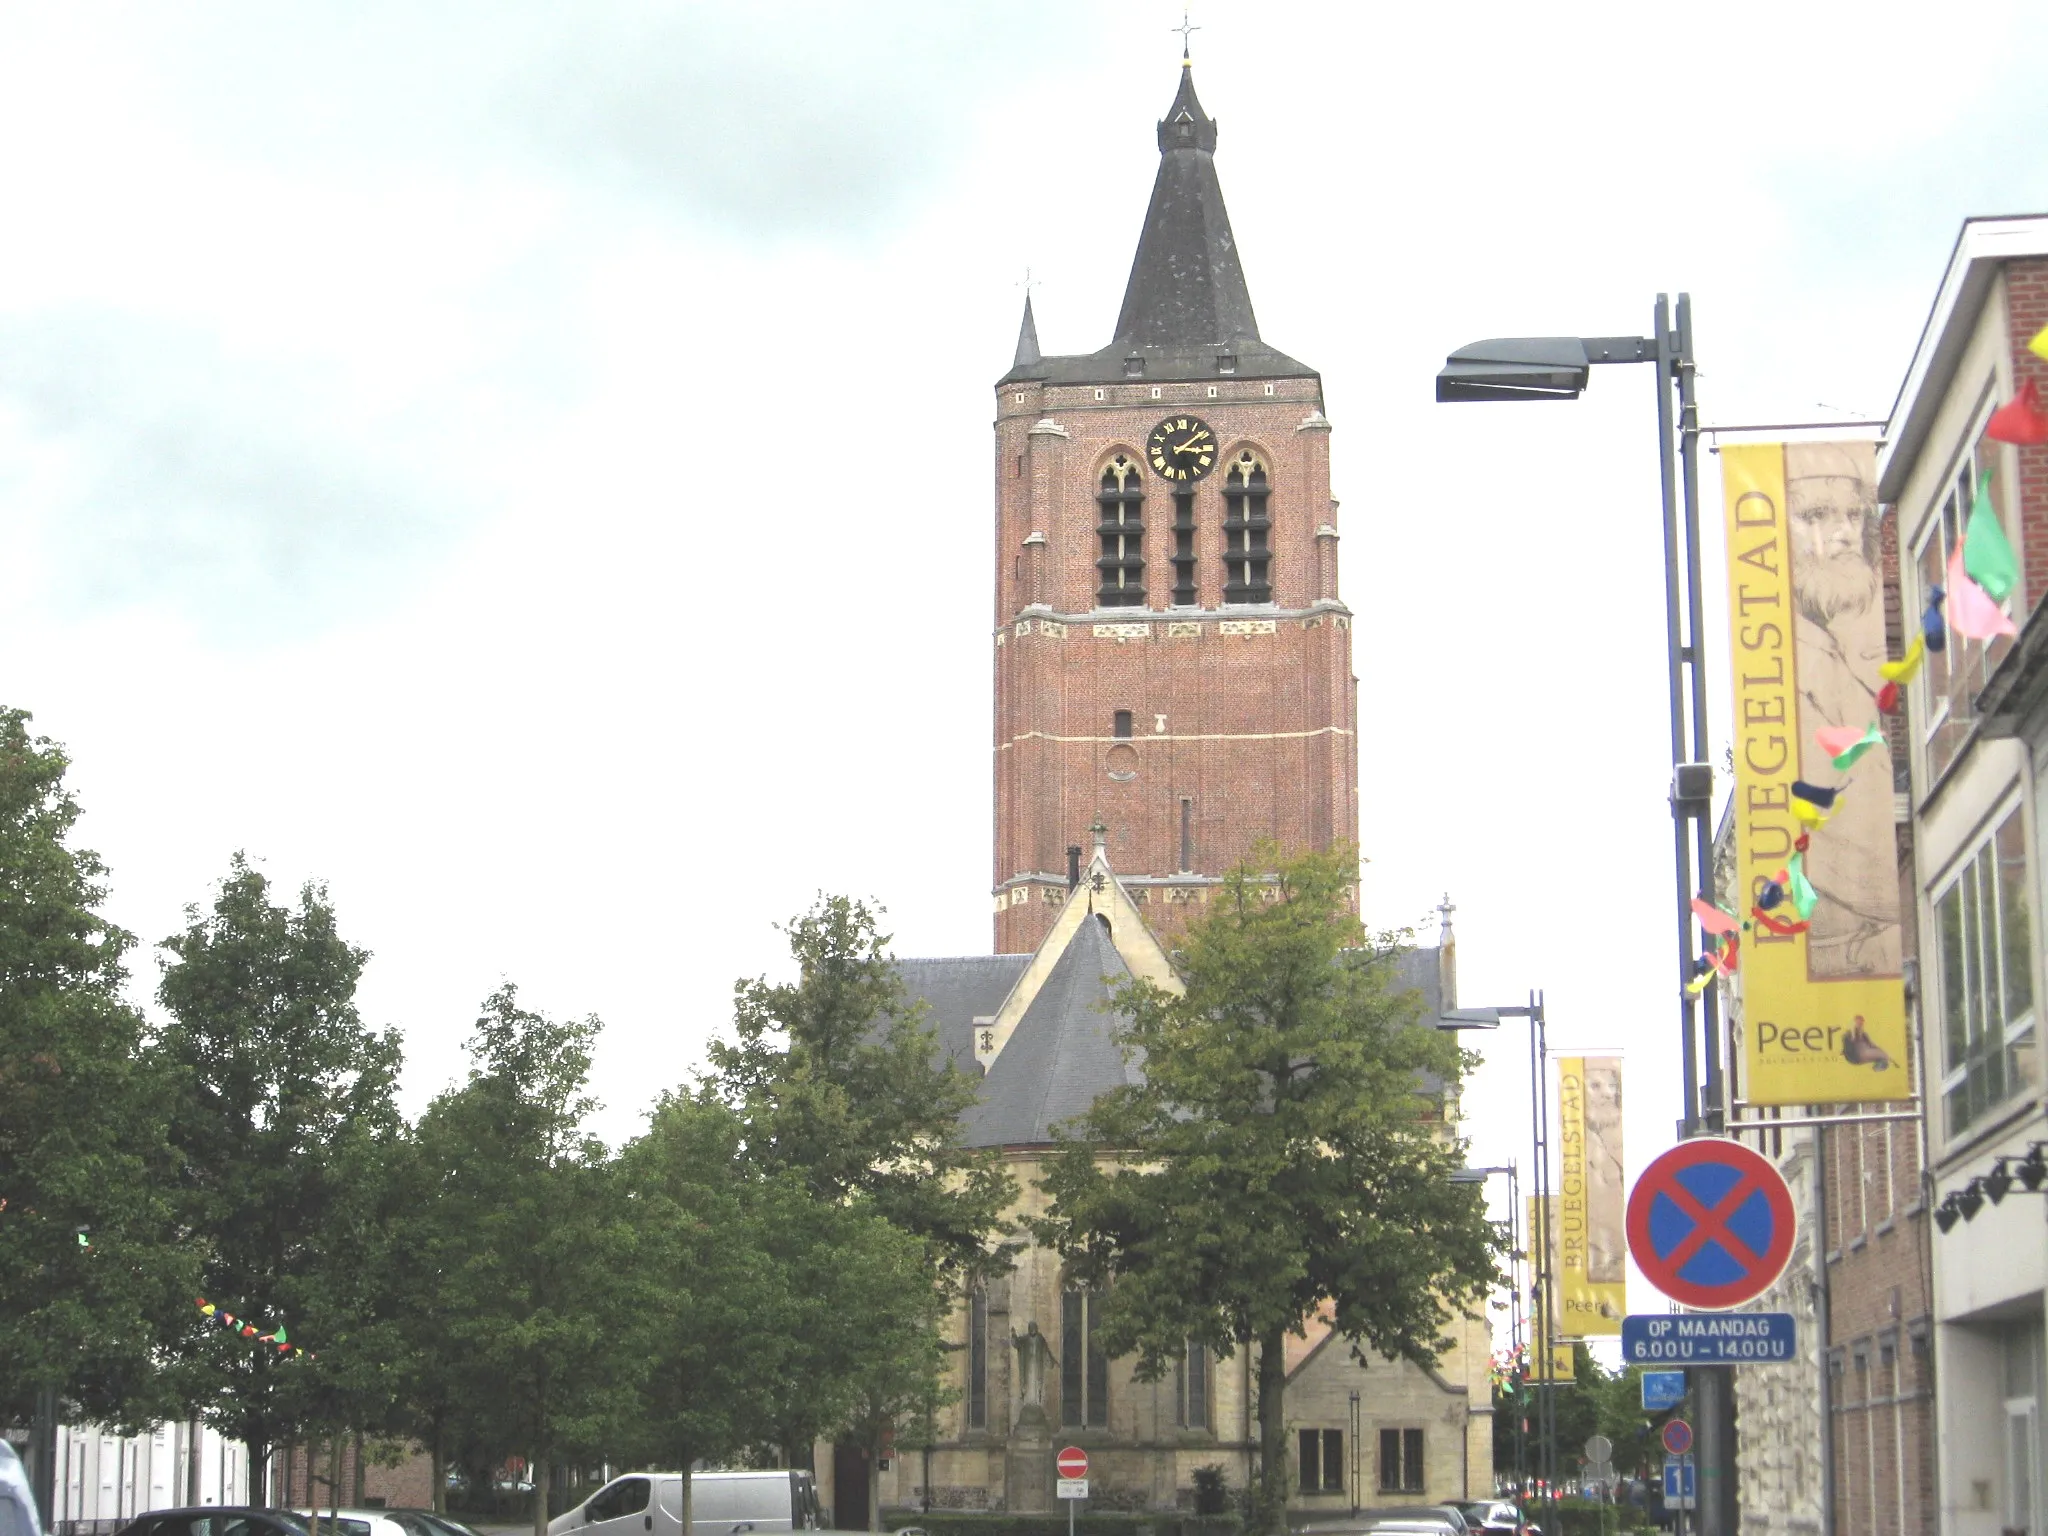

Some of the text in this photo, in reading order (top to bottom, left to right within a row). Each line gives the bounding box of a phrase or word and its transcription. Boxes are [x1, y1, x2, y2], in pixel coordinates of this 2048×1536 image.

[1758, 1021, 1842, 1053] Peer
[1562, 1073, 1584, 1269] BRUEGELSTAD
[1566, 1299, 1602, 1313] Peer
[1648, 1319, 1770, 1337] OP MAANDAG
